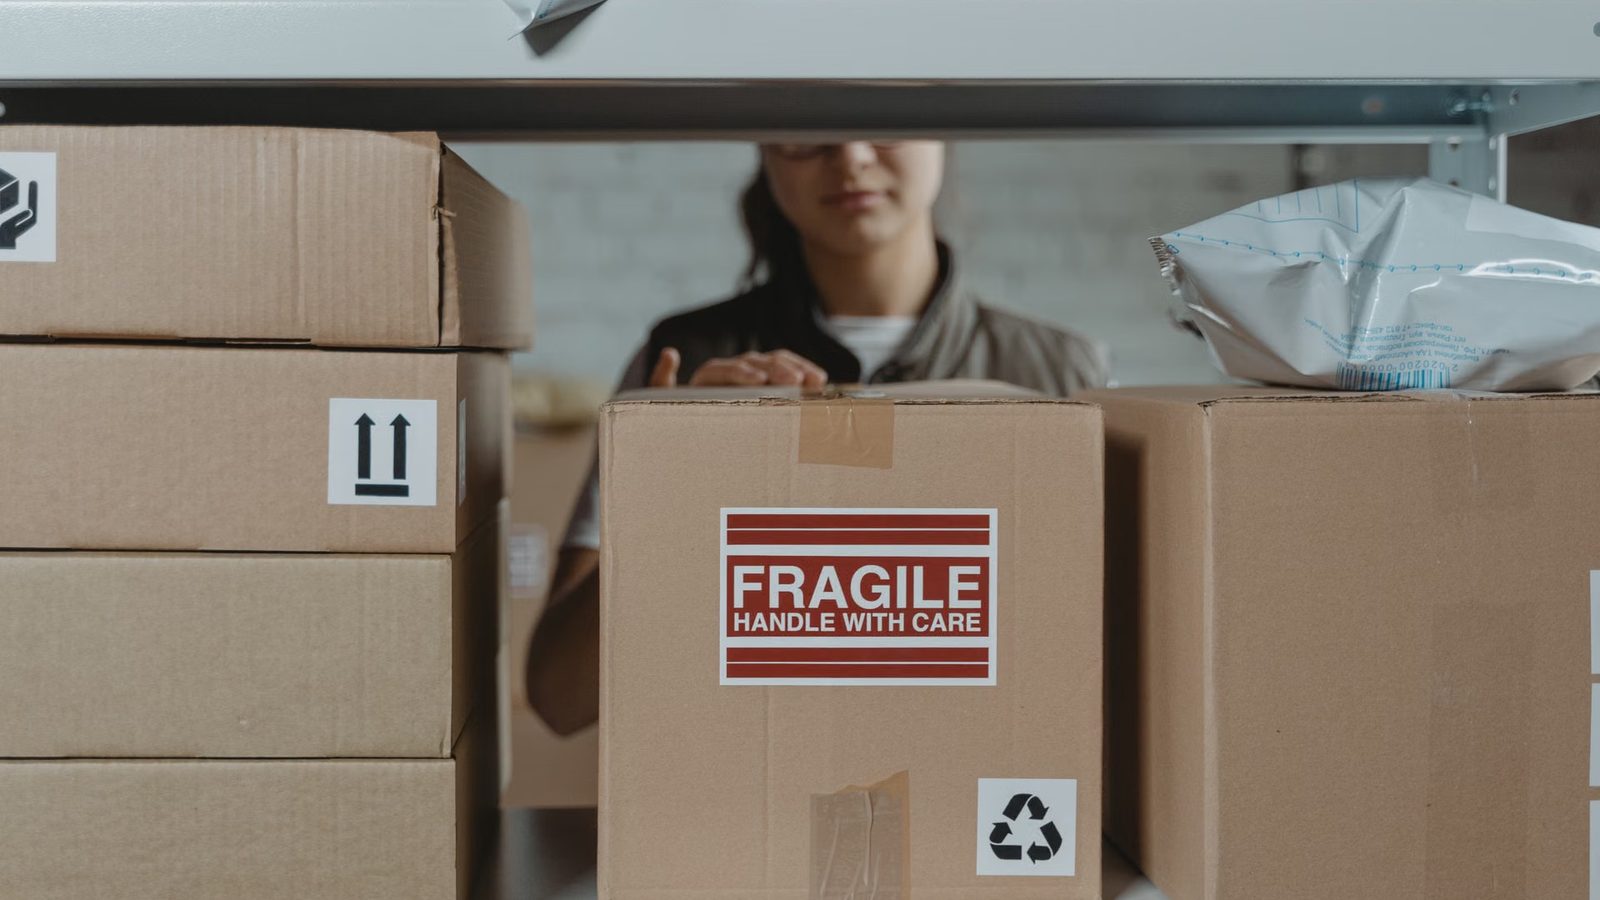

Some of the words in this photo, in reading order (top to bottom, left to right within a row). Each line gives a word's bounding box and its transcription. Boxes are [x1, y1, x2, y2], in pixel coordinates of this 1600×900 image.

[733, 564, 982, 609] FRAGILE
[733, 612, 836, 632] HANDLE
[842, 612, 905, 632] WITH
[912, 612, 982, 632] CARE
